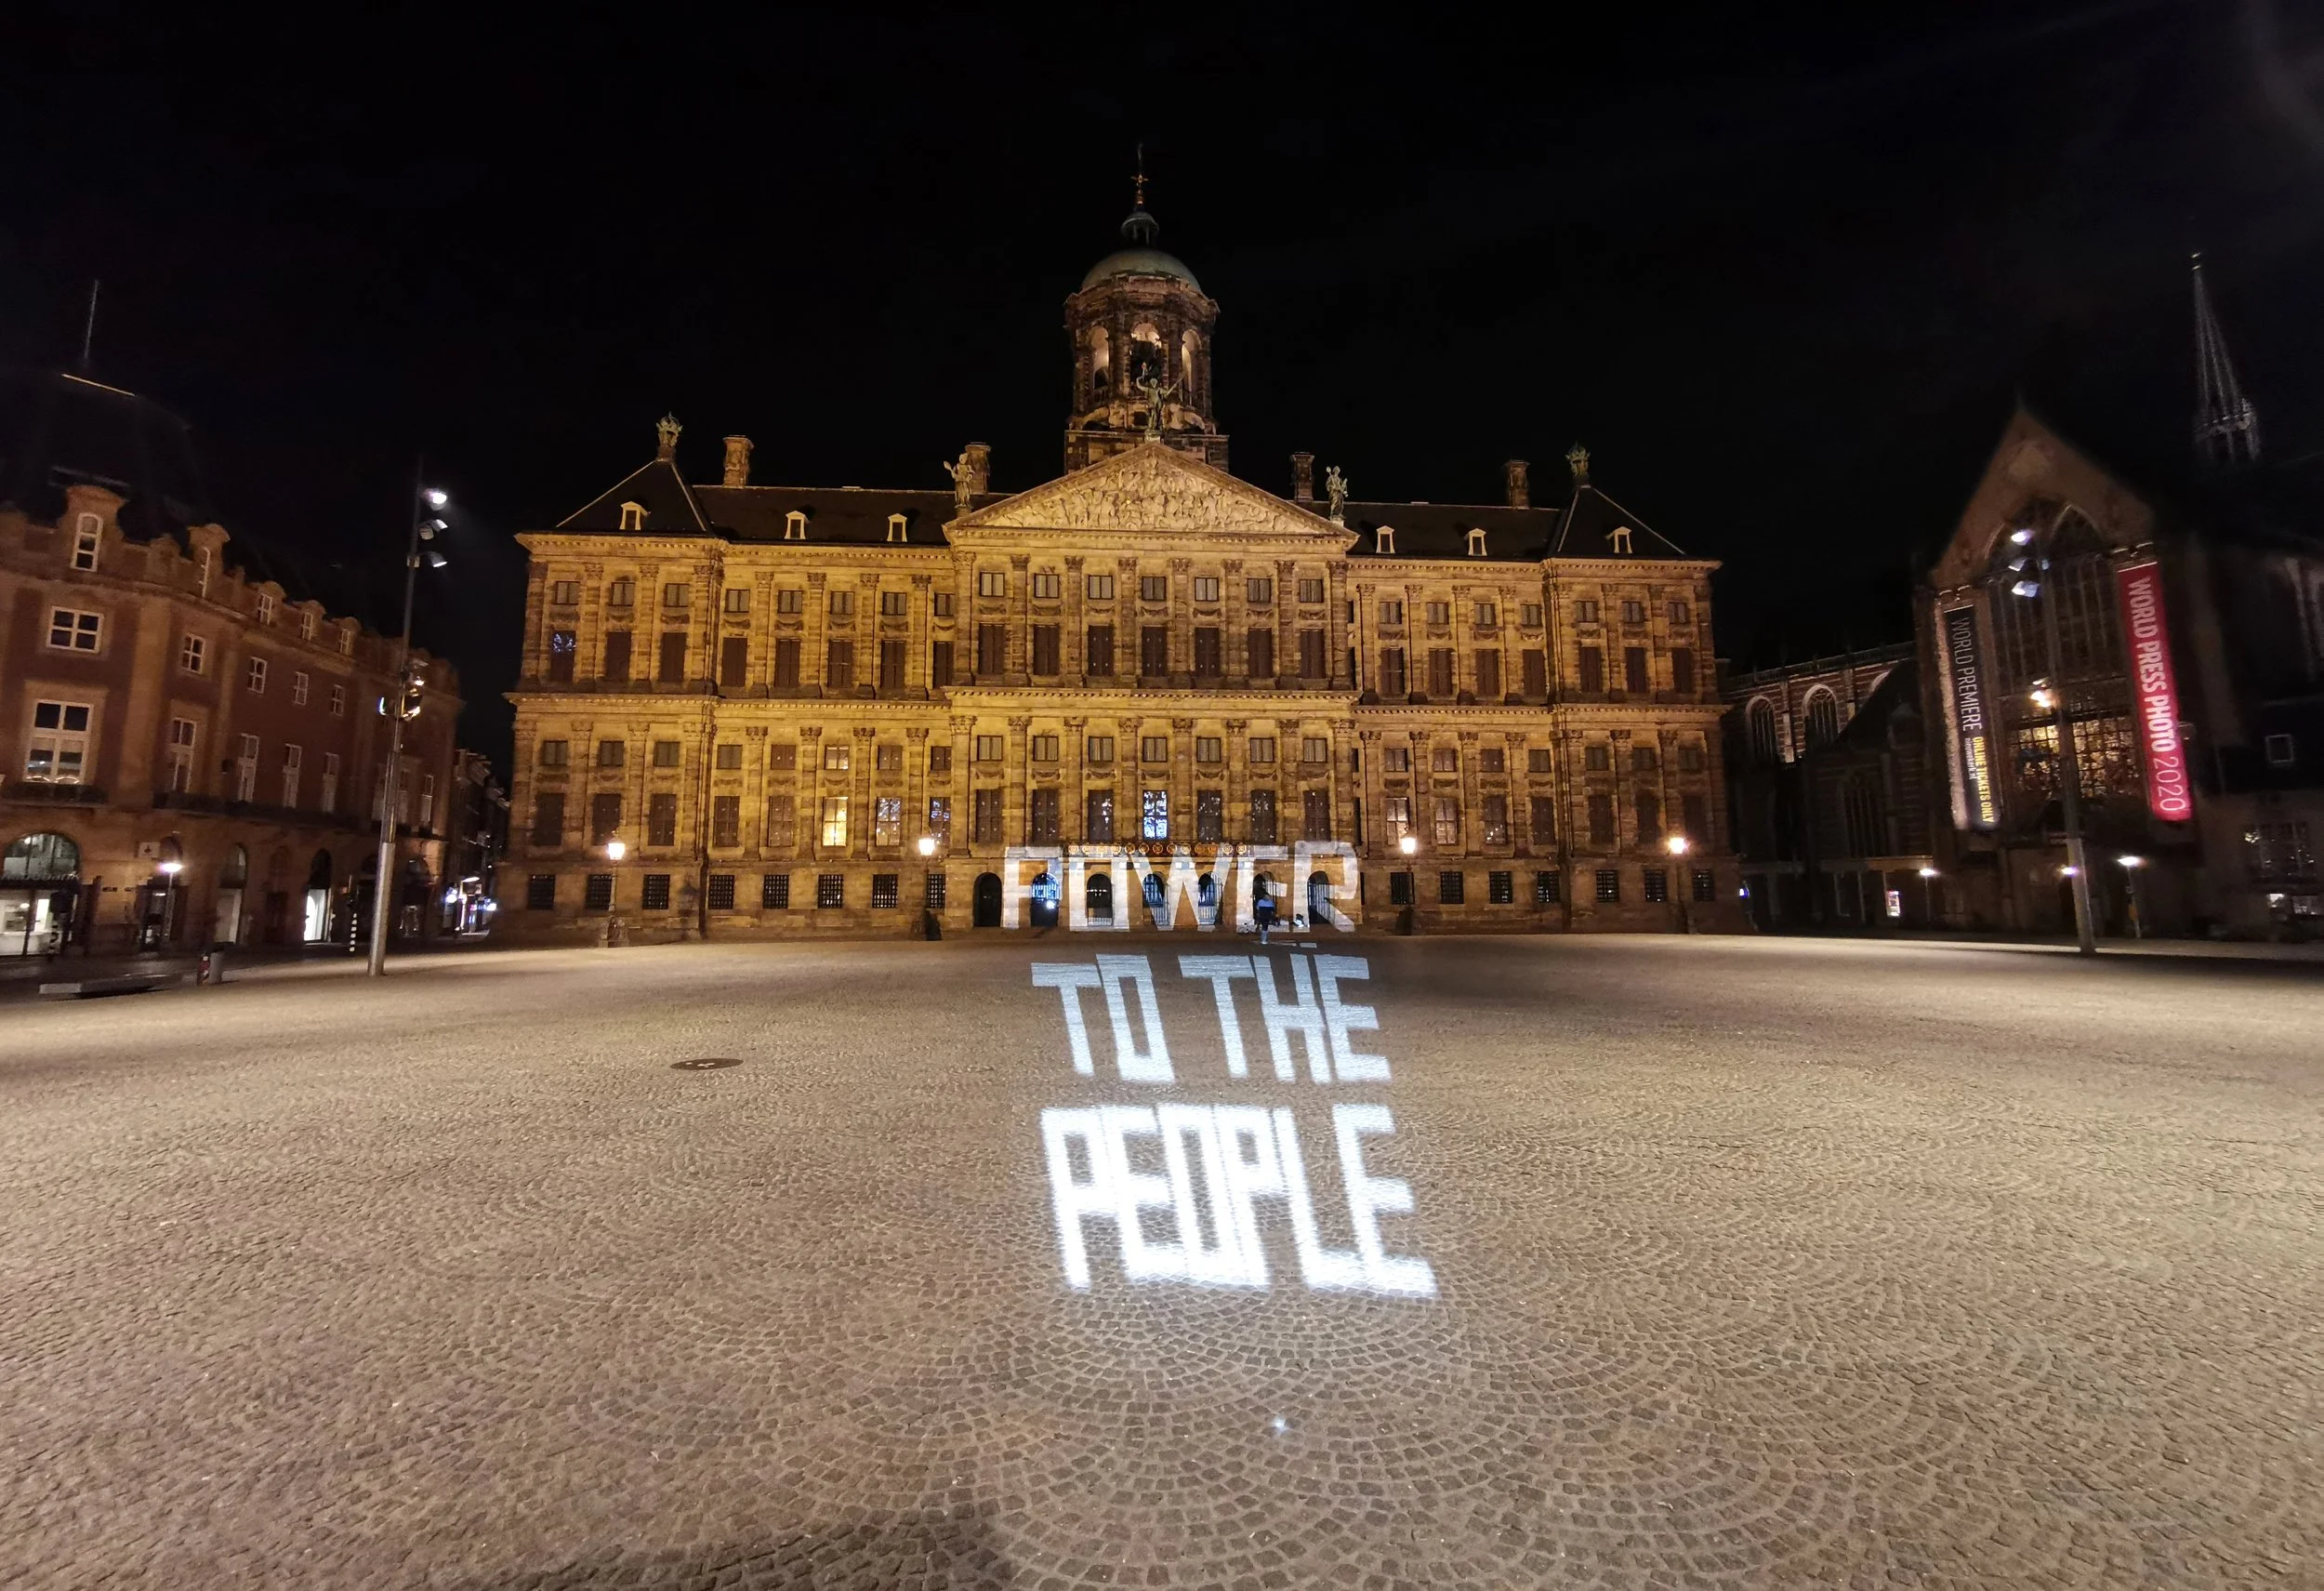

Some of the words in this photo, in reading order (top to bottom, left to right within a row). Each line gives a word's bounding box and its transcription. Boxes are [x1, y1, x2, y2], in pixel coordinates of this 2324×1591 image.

[2129, 577, 2159, 639] WORLD
[1951, 617, 1974, 665] WORLD
[2135, 640, 2167, 693] PRESS
[1957, 667, 1983, 732] PREMIERE
[2145, 694, 2176, 752] PHOTO
[1973, 736, 1987, 766] ONLINE
[1976, 767, 1991, 802] TICKETS
[1981, 802, 1995, 824] ONLY
[2154, 756, 2185, 813] 2020
[1001, 841, 1359, 933] POWER
[1031, 954, 1176, 1083] TO
[1178, 953, 1392, 1085] THE
[1040, 1103, 1437, 1297] PEOPLE
